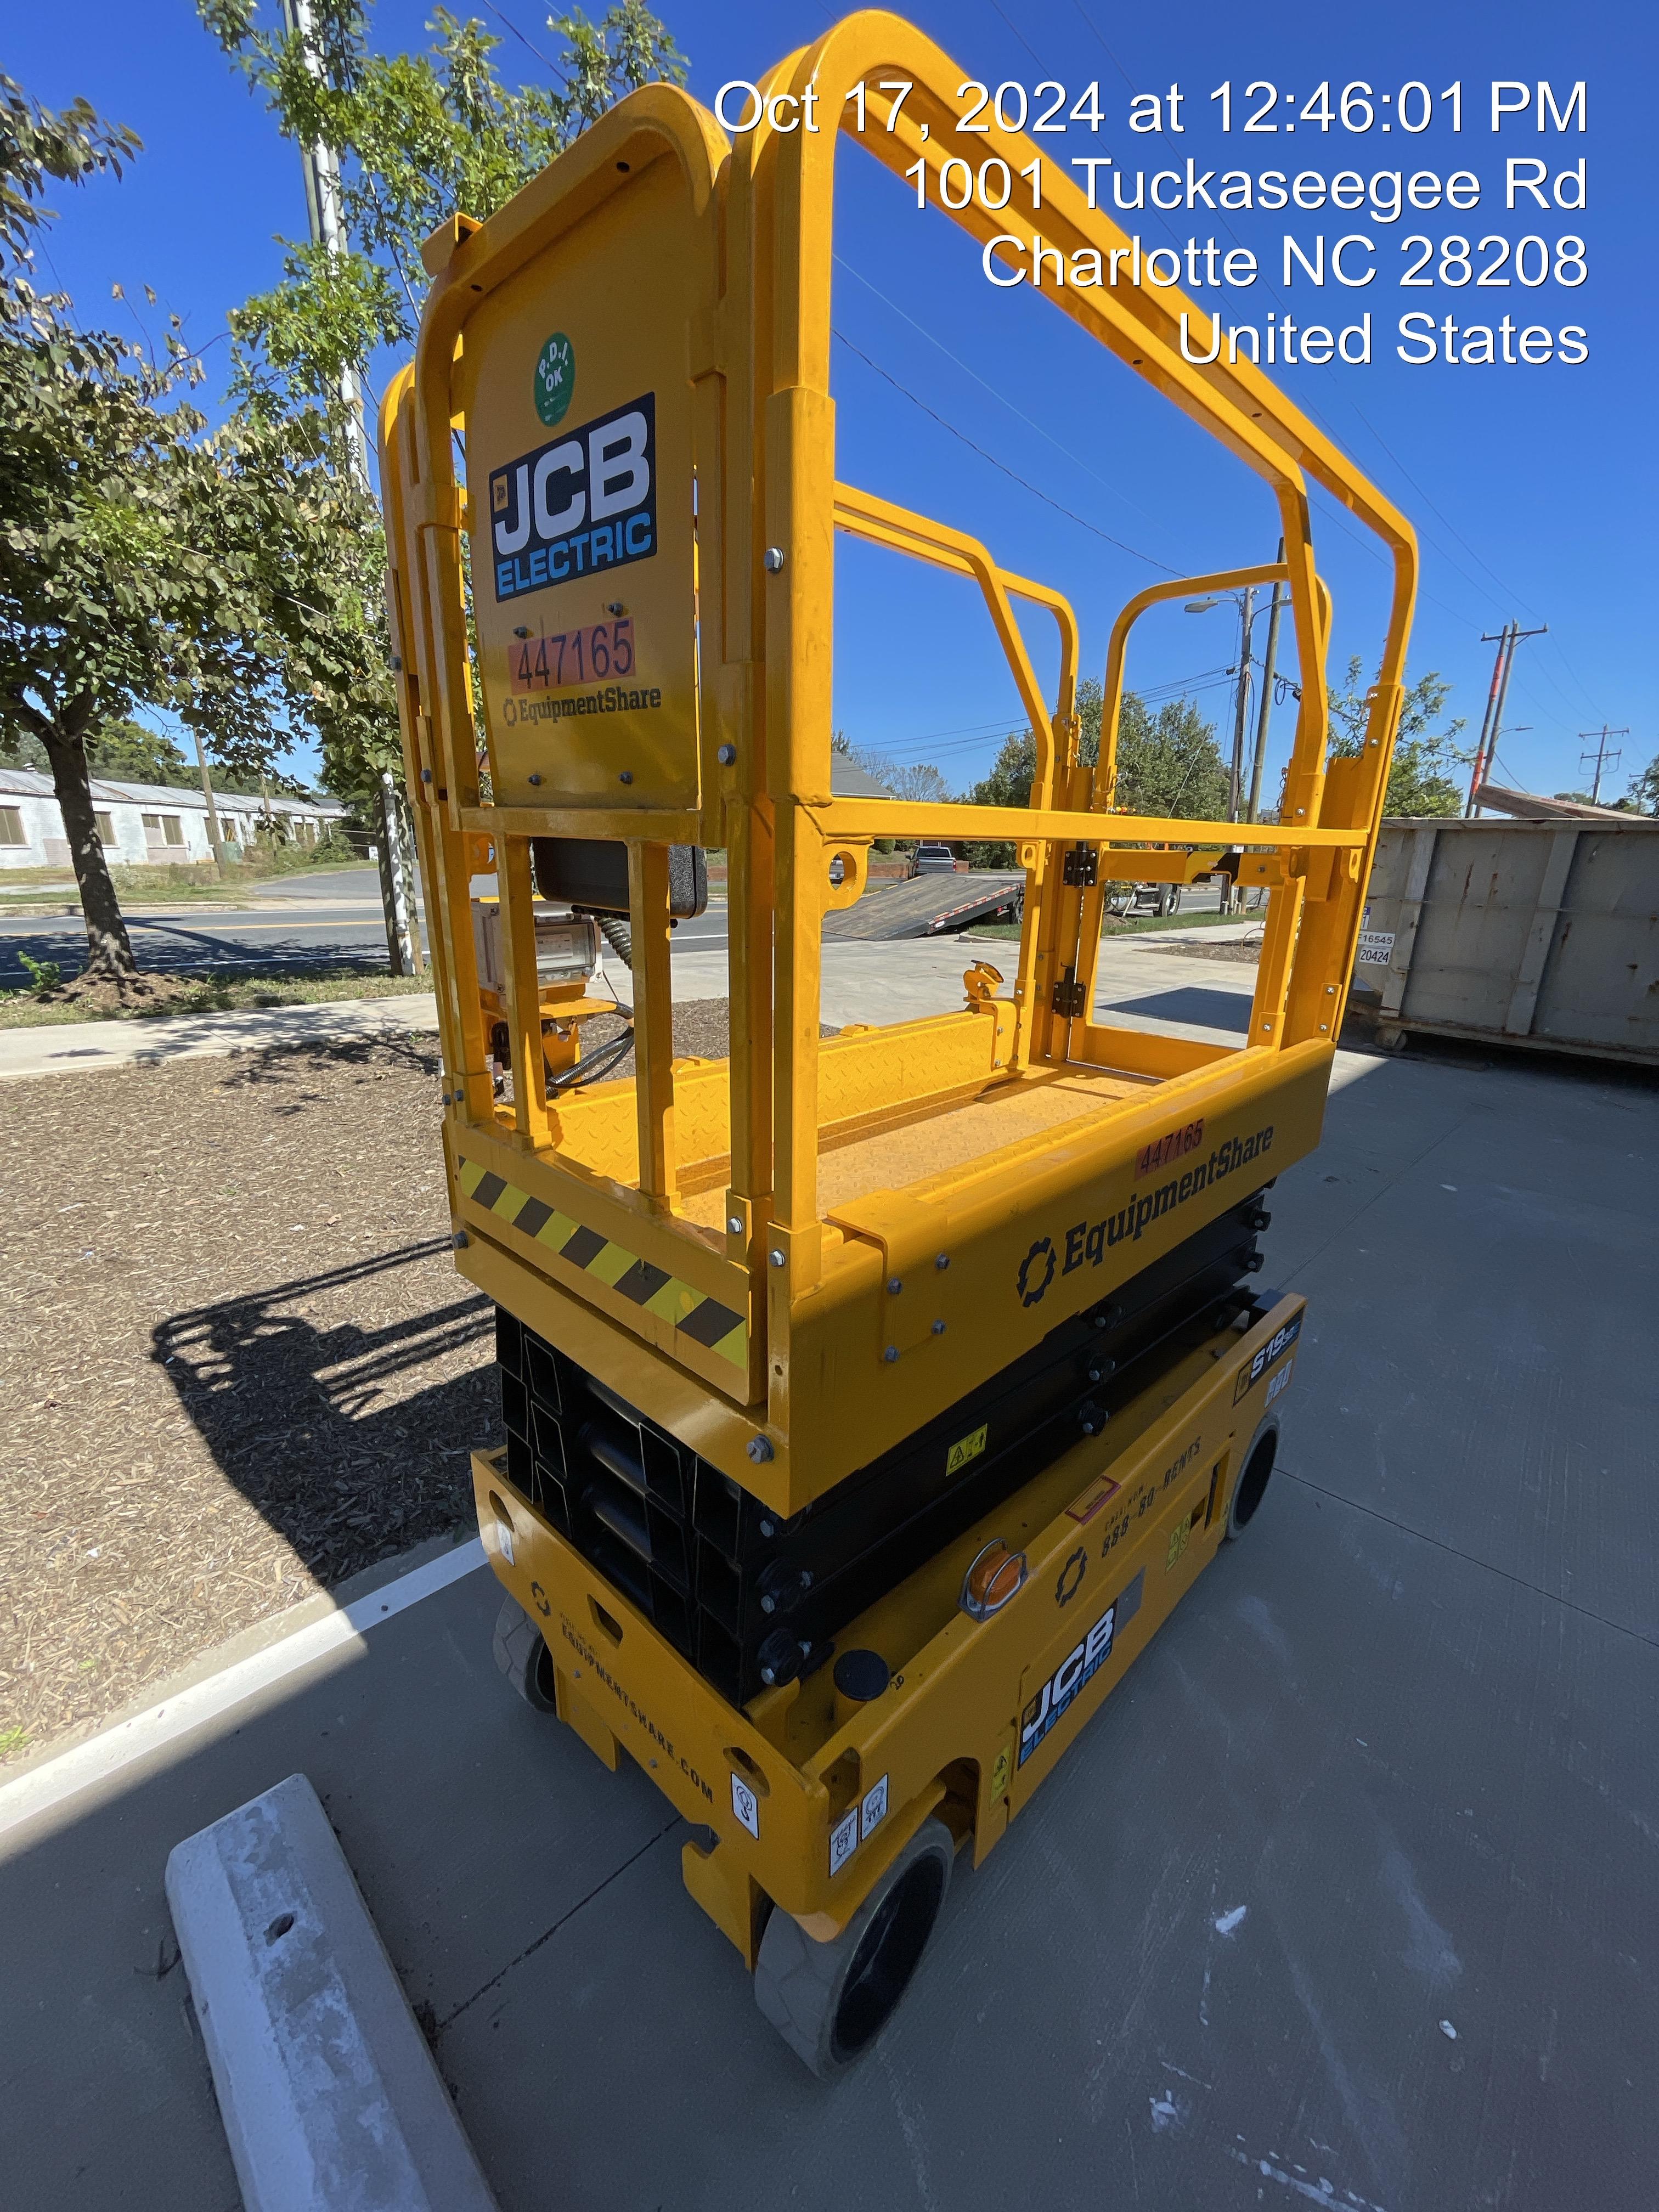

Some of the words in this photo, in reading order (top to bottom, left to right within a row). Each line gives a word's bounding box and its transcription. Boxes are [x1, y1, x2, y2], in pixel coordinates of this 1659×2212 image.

[545, 366, 563, 392] OK
[495, 411, 651, 556] JCB
[497, 512, 652, 597] ELECTRIC
[518, 619, 632, 689] 447165
[518, 686, 662, 726] EquipmentShare
[1361, 950, 1390, 963] 20424
[1141, 1118, 1204, 1174] 447165
[1062, 1126, 1274, 1276] EquipmentShare
[1020, 1641, 1112, 1765] ELECTRIC
[1023, 1607, 1115, 1743] JCB
